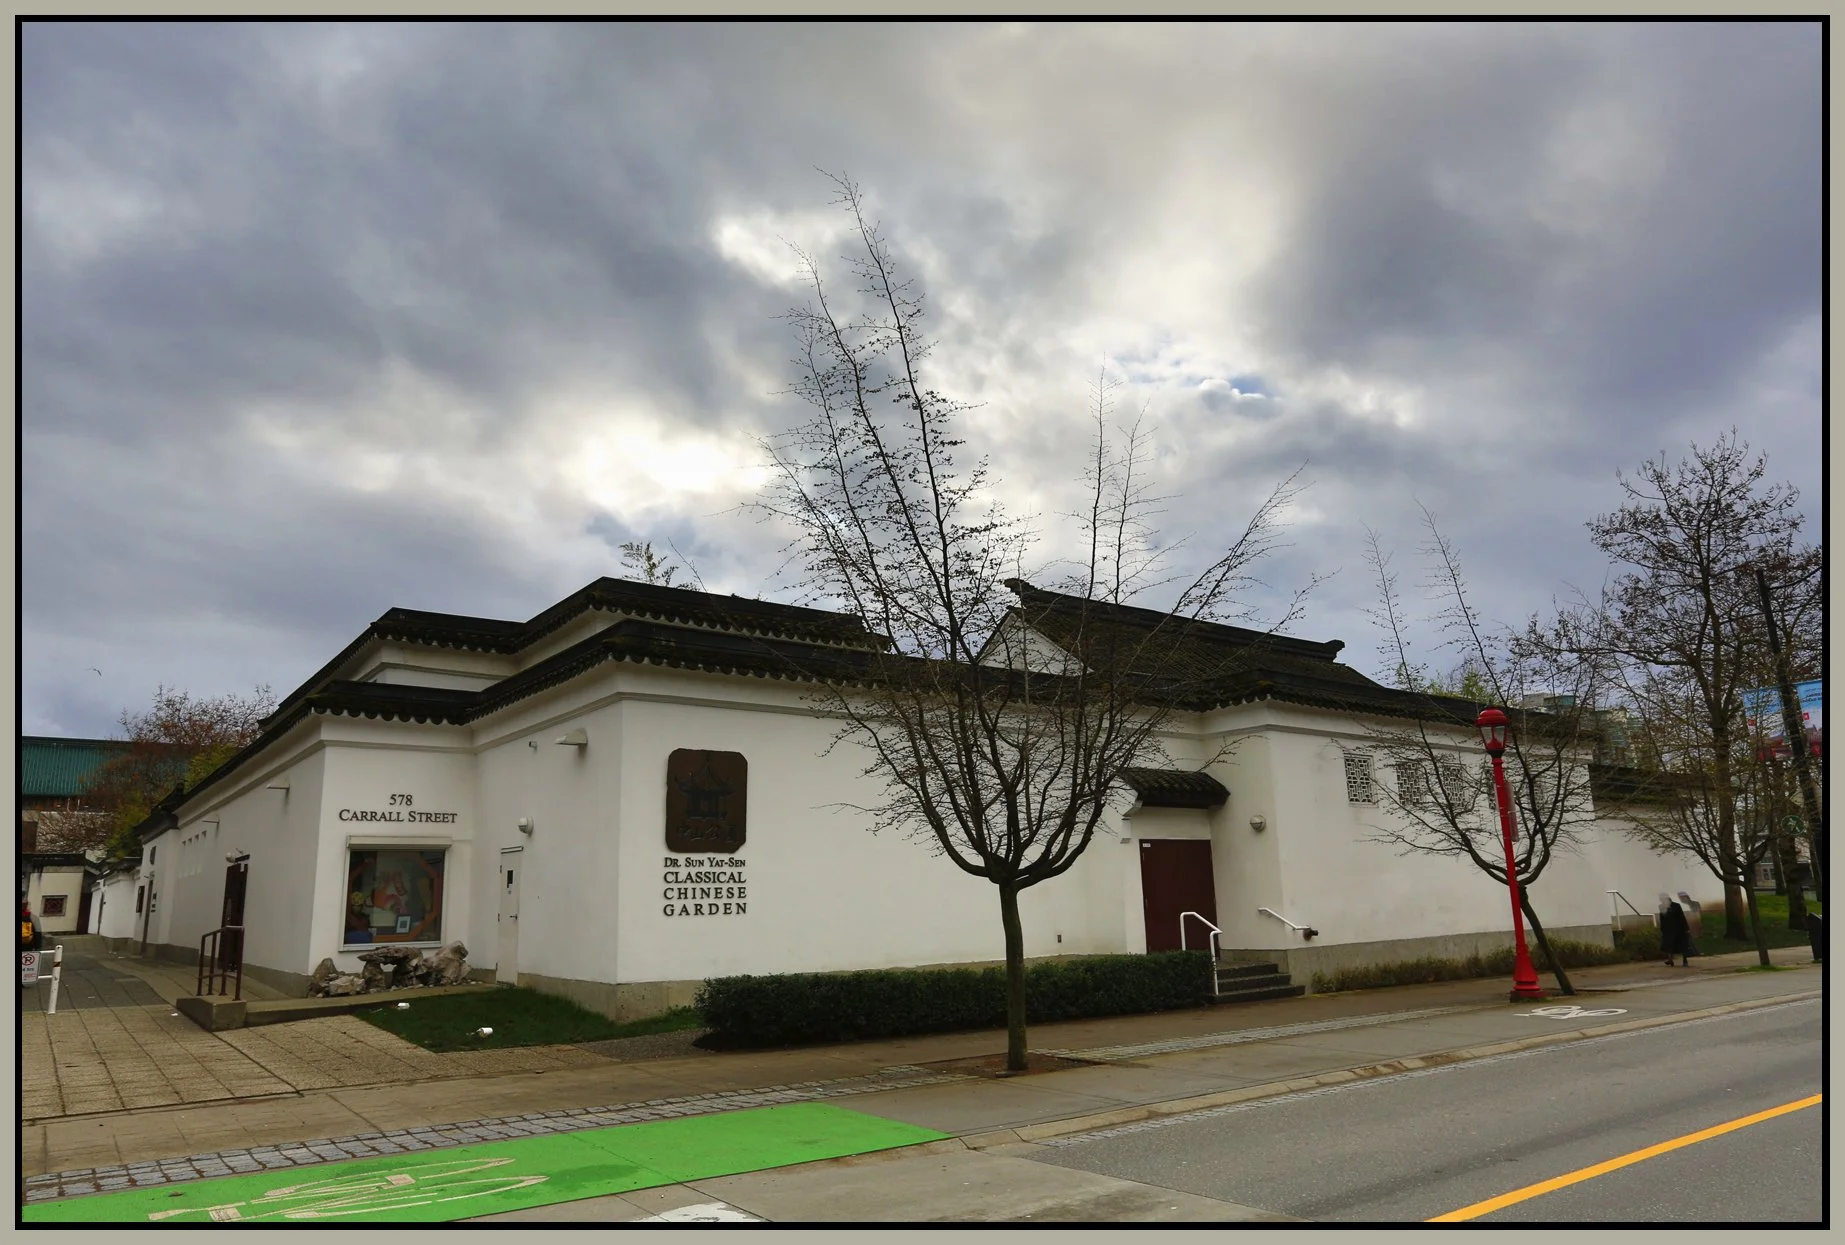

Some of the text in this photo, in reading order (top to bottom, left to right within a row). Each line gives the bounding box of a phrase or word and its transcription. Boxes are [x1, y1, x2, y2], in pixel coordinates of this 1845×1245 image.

[389, 794, 413, 806] 578
[663, 871, 747, 884] CLASSICAL
[663, 887, 747, 900] CHINESE
[663, 903, 747, 916] GARDEN
